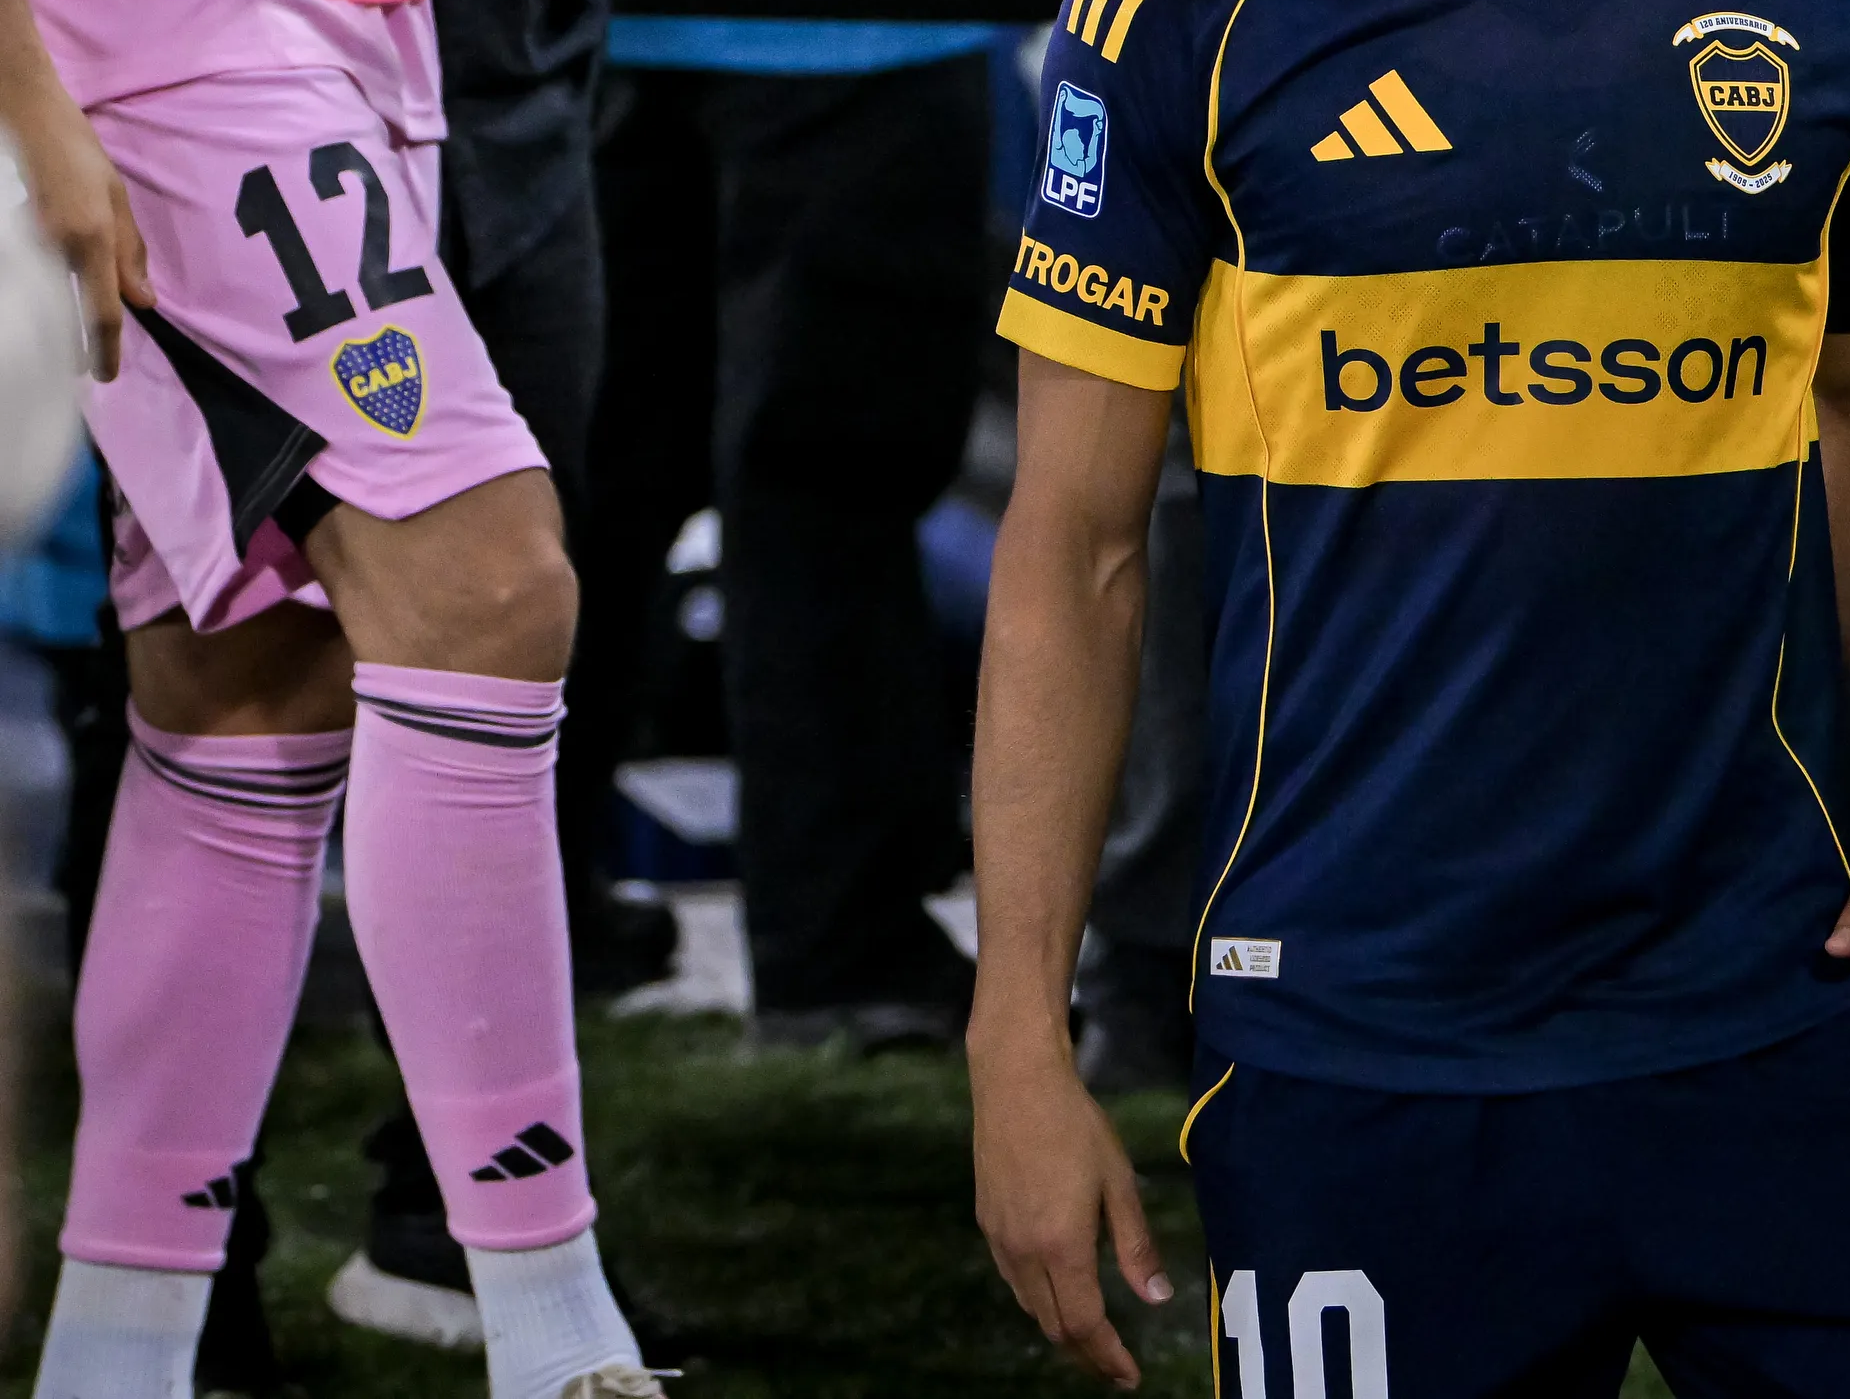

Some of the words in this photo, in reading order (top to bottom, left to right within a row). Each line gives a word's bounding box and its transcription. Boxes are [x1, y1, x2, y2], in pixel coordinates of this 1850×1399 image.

[1699, 18, 1714, 30] 120
[1715, 16, 1768, 32] ANIVERSARIO
[1709, 85, 1775, 108] CABJ
[1044, 167, 1099, 212] LPF
[1755, 173, 1773, 188] 2025
[234, 141, 433, 342] 12
[1320, 321, 1768, 414] betsson
[1221, 1269, 1389, 1399] 10
